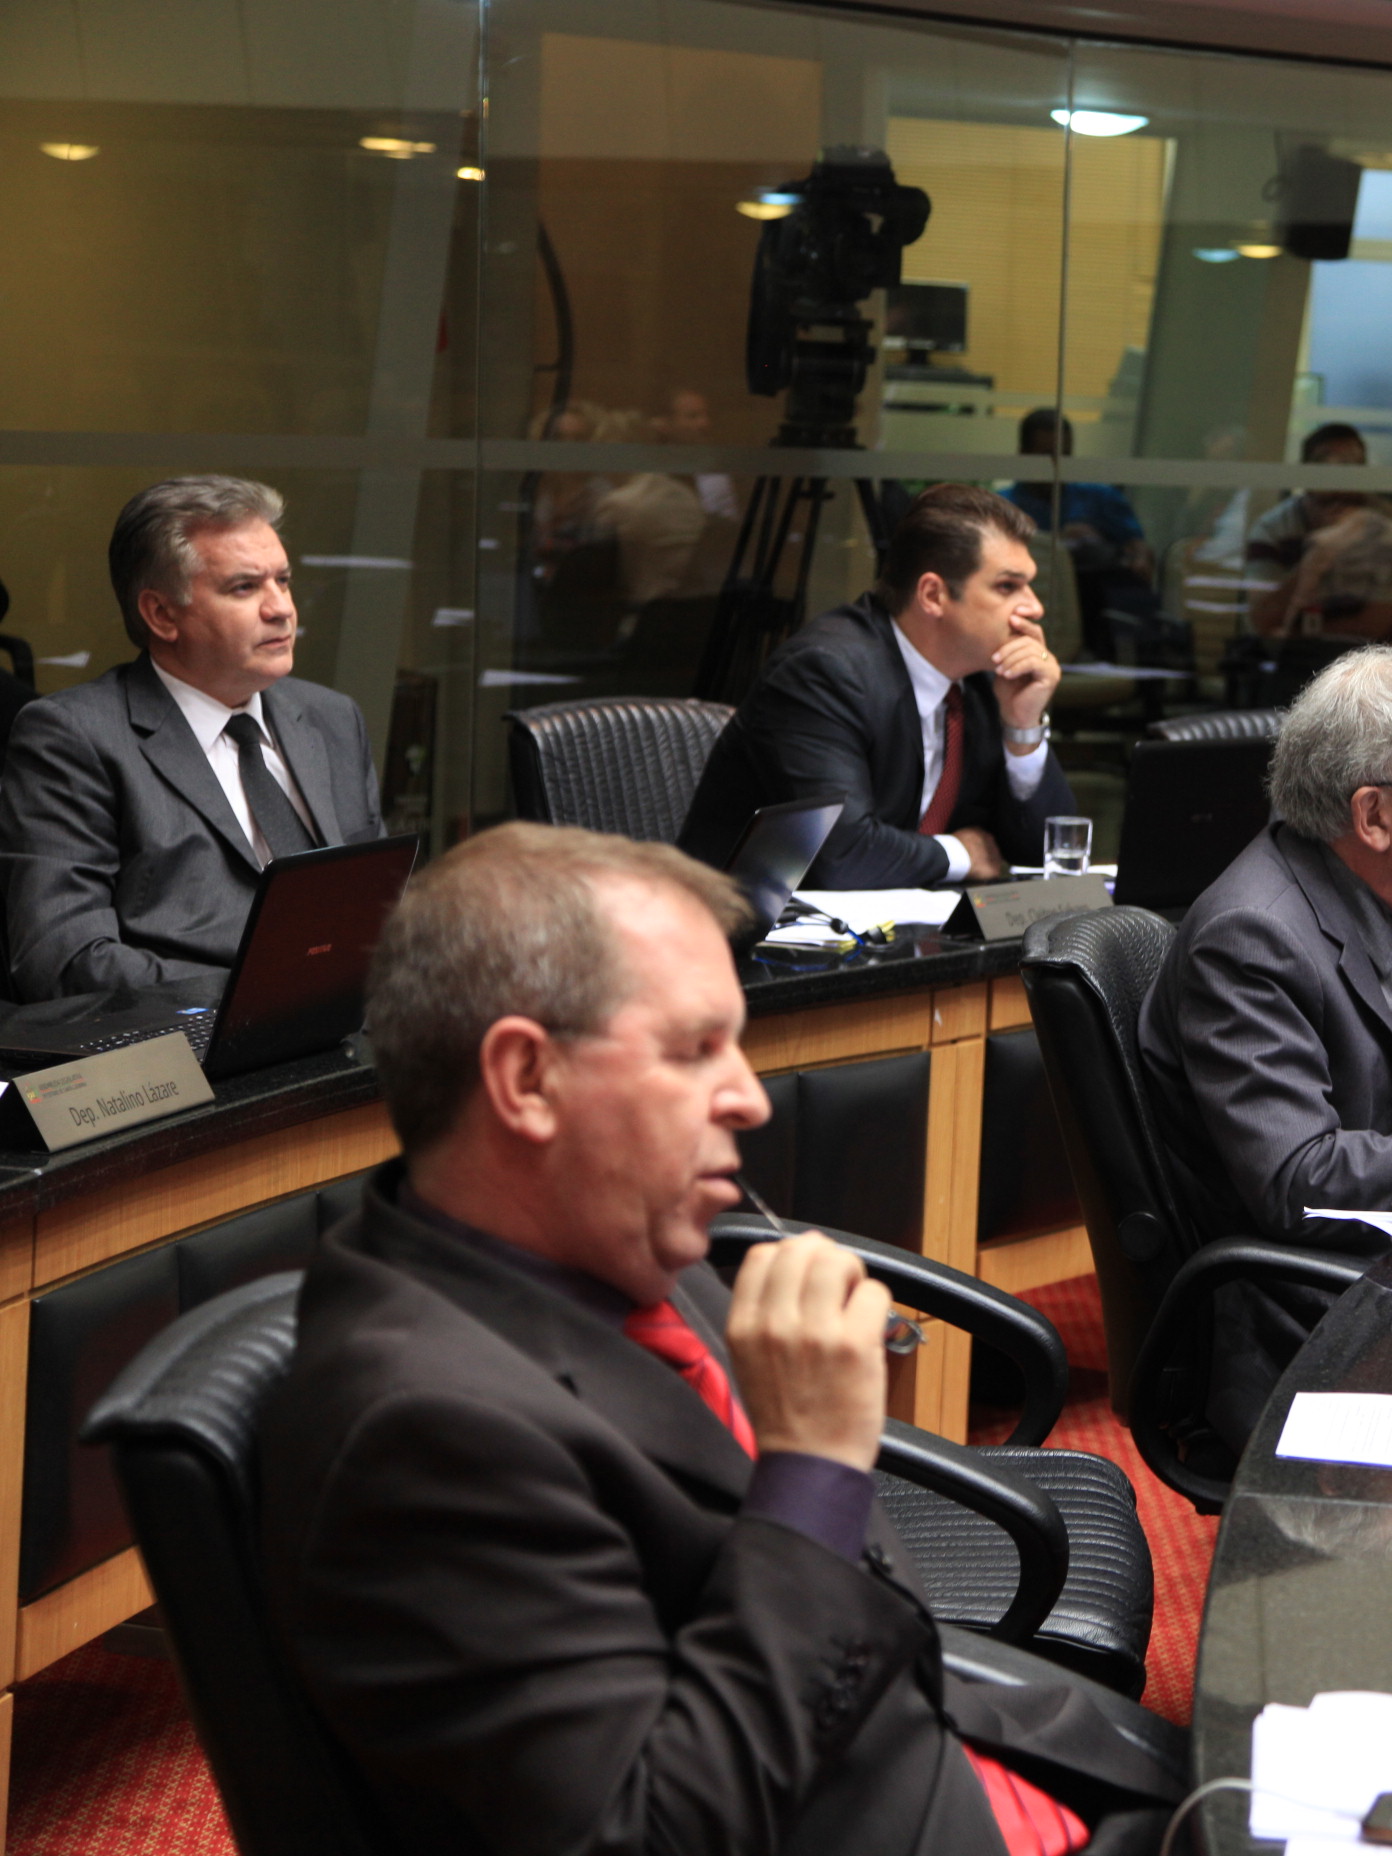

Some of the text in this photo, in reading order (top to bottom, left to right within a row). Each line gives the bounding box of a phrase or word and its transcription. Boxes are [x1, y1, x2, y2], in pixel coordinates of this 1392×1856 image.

[69, 1106, 99, 1127] Dep.
[96, 1090, 144, 1118] Natalino
[142, 1081, 180, 1103] Lázare
